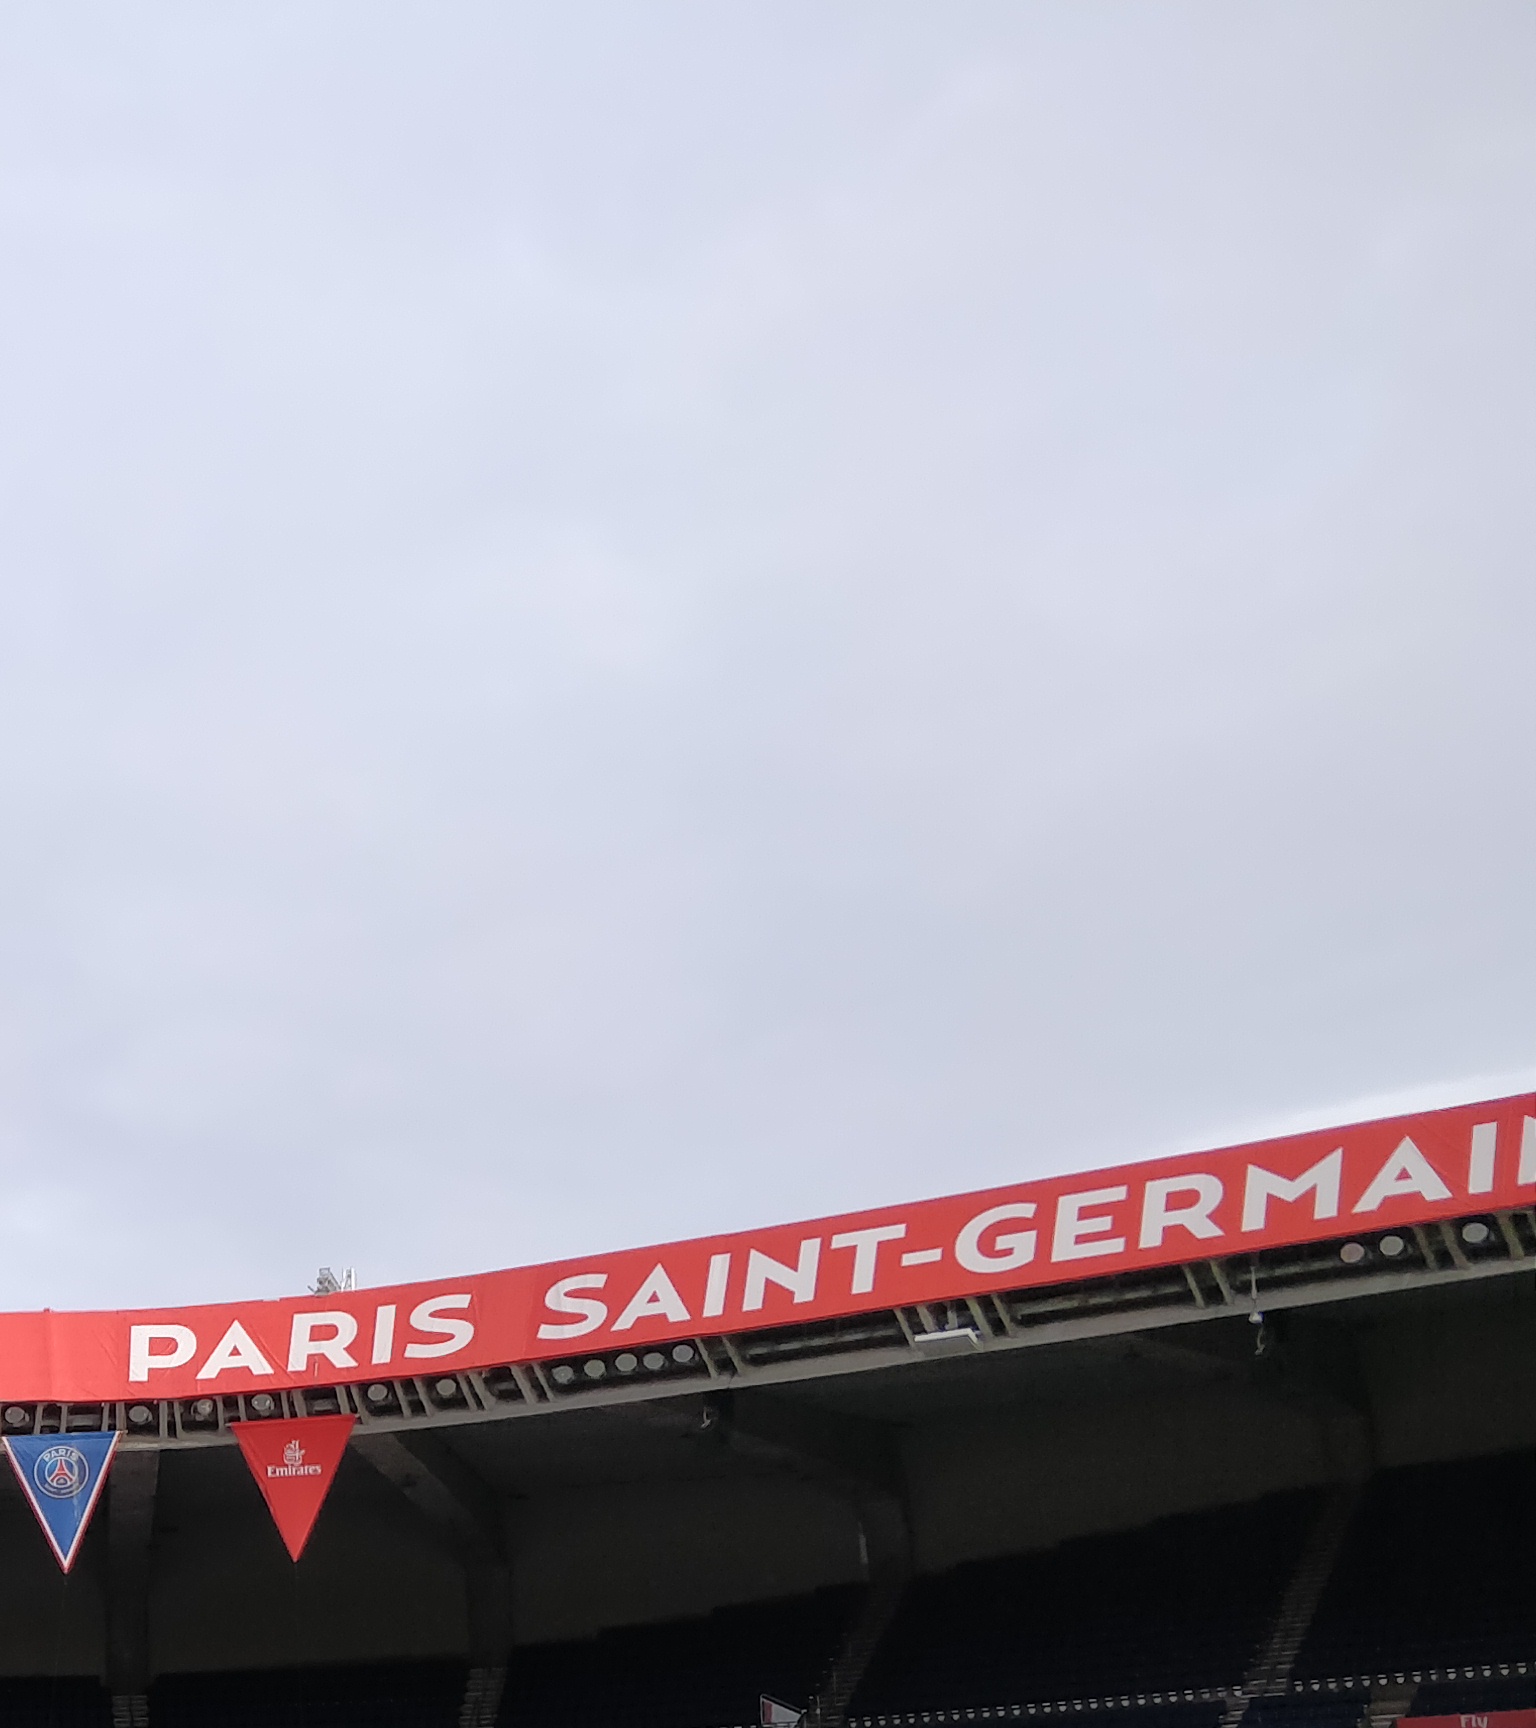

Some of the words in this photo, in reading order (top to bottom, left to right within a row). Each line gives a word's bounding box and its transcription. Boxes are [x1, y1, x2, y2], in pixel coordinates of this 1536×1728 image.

[128, 1293, 475, 1383] PARIS
[535, 1113, 1536, 1341] SAINT-GERMAI
[42, 1448, 79, 1462] PARIS
[266, 1463, 322, 1478] Emirates
[1460, 1714, 1488, 1728] Fly
